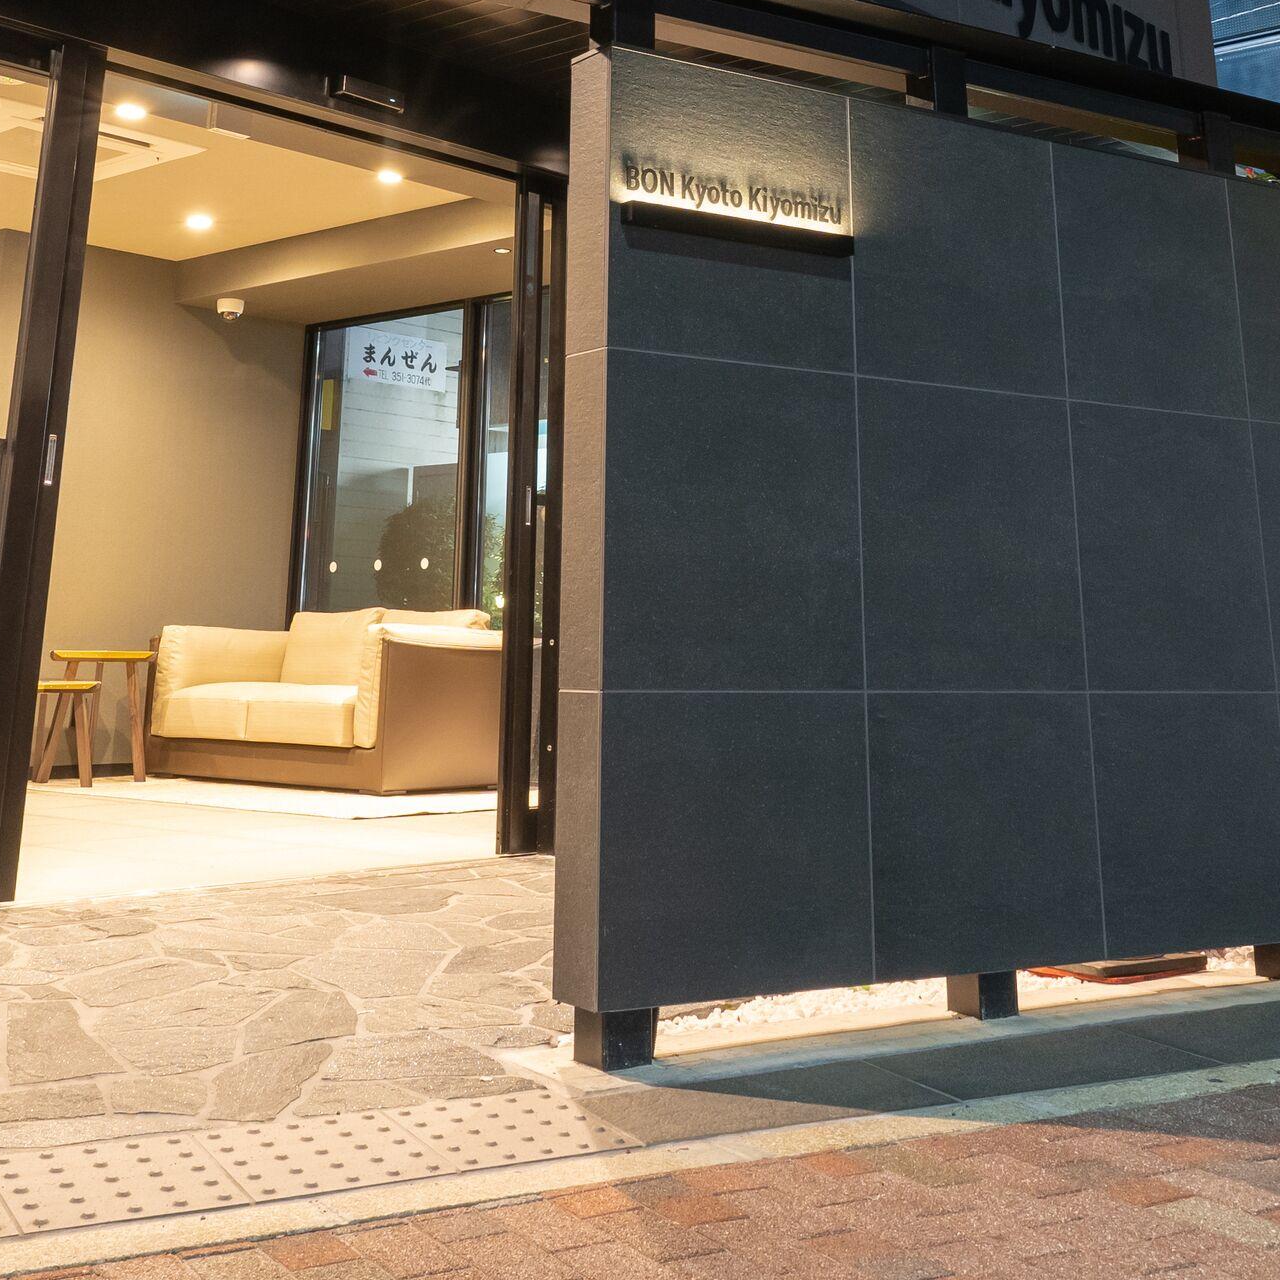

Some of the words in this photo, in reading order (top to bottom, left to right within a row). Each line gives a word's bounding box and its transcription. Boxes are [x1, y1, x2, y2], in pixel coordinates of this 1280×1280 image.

[626, 166, 674, 197] BON
[681, 174, 742, 209] Kyoto
[748, 186, 842, 225] Kiyomizu
[363, 343, 437, 374] まんぜん
